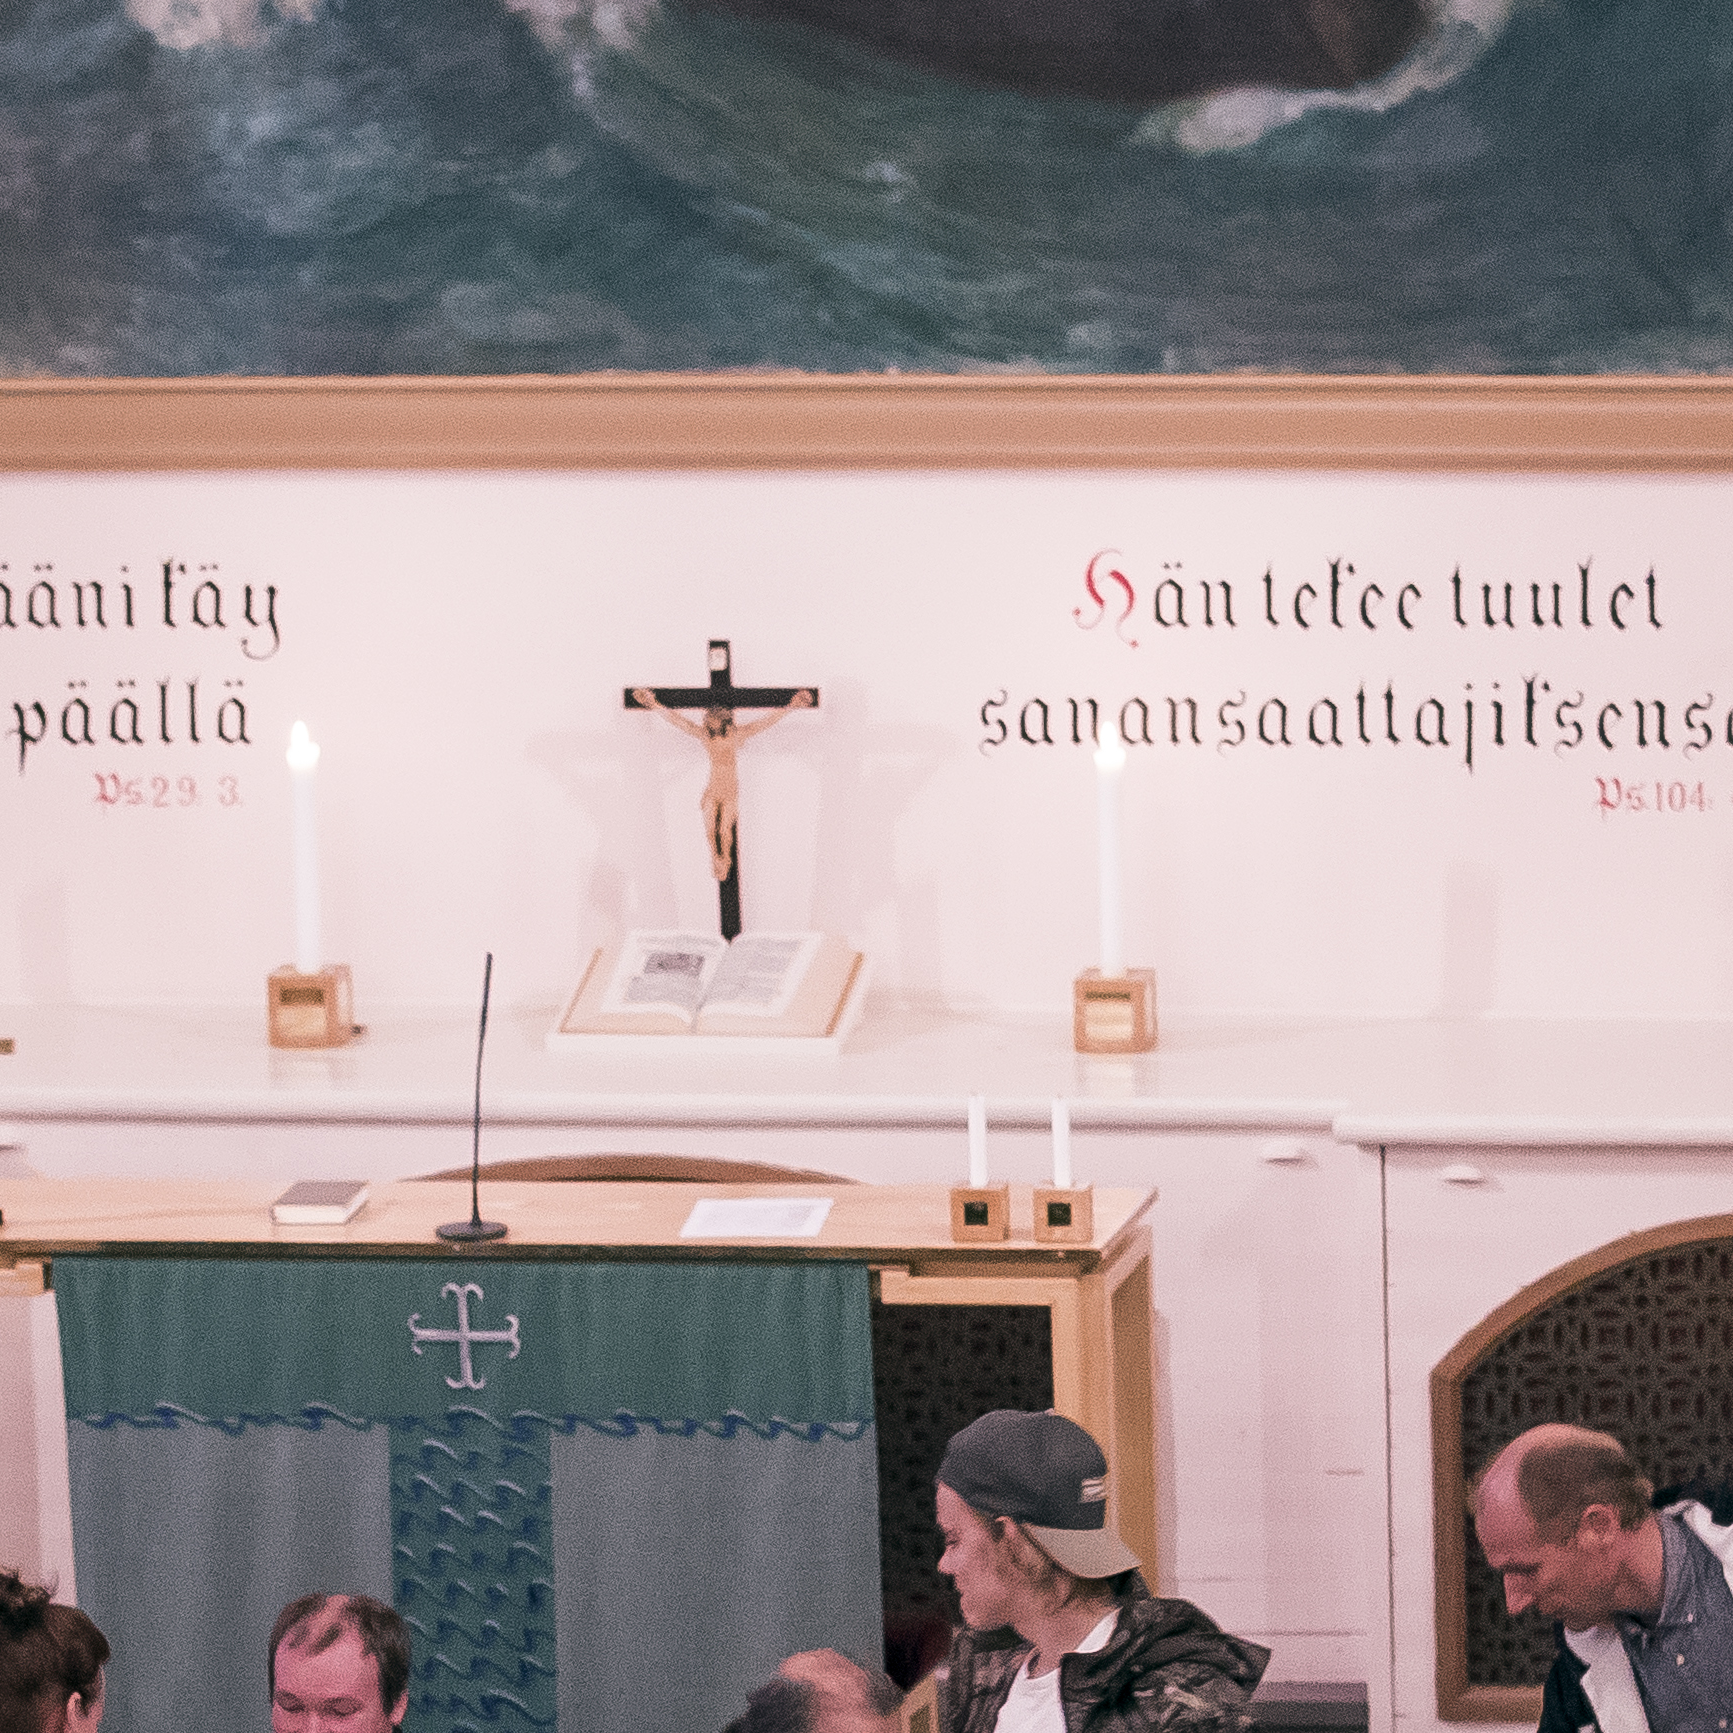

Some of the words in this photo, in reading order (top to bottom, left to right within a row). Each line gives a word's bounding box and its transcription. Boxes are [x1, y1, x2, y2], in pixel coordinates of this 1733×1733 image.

[160, 557, 281, 660] käy
[1071, 548, 1237, 649] Hän
[1262, 554, 1422, 630] tekee
[1449, 554, 1664, 630] tuulet
[6, 678, 253, 776] päällä
